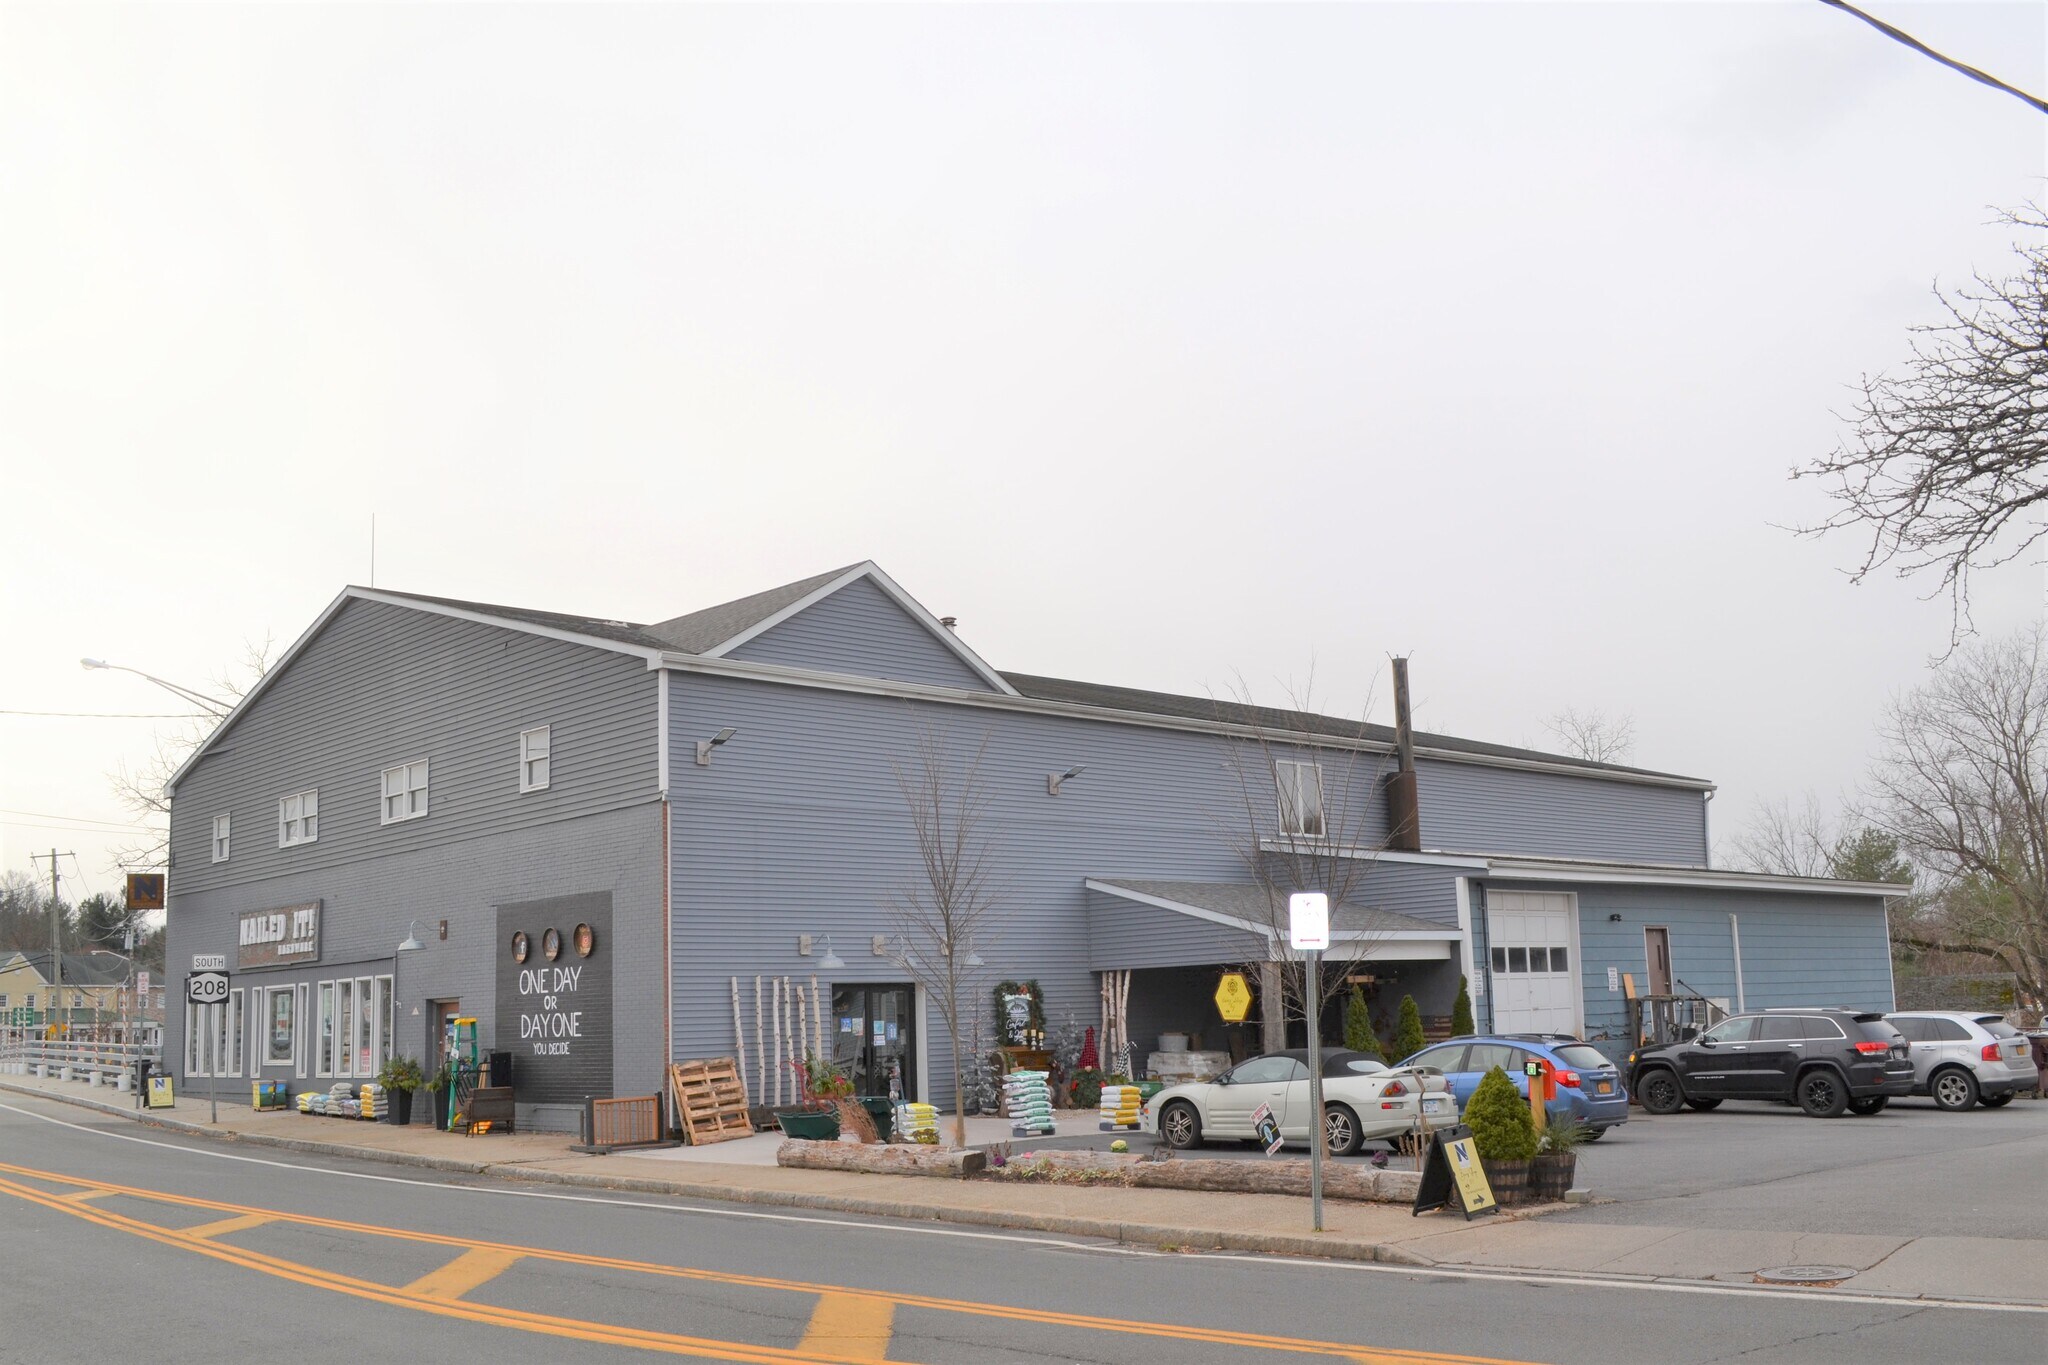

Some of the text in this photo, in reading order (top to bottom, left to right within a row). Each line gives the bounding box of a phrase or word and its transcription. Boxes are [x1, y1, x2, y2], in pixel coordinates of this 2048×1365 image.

[134, 876, 157, 900] N
[240, 908, 315, 946] NAILED IT!
[195, 957, 224, 968] SOUTH
[192, 980, 226, 996] 208
[519, 966, 582, 995] ONE DAY
[543, 995, 557, 1010] OR
[521, 1012, 582, 1038] DAY ONE
[533, 1042, 570, 1055] YOU DECIDE
[155, 1079, 165, 1088] N
[1454, 1142, 1469, 1163] N
